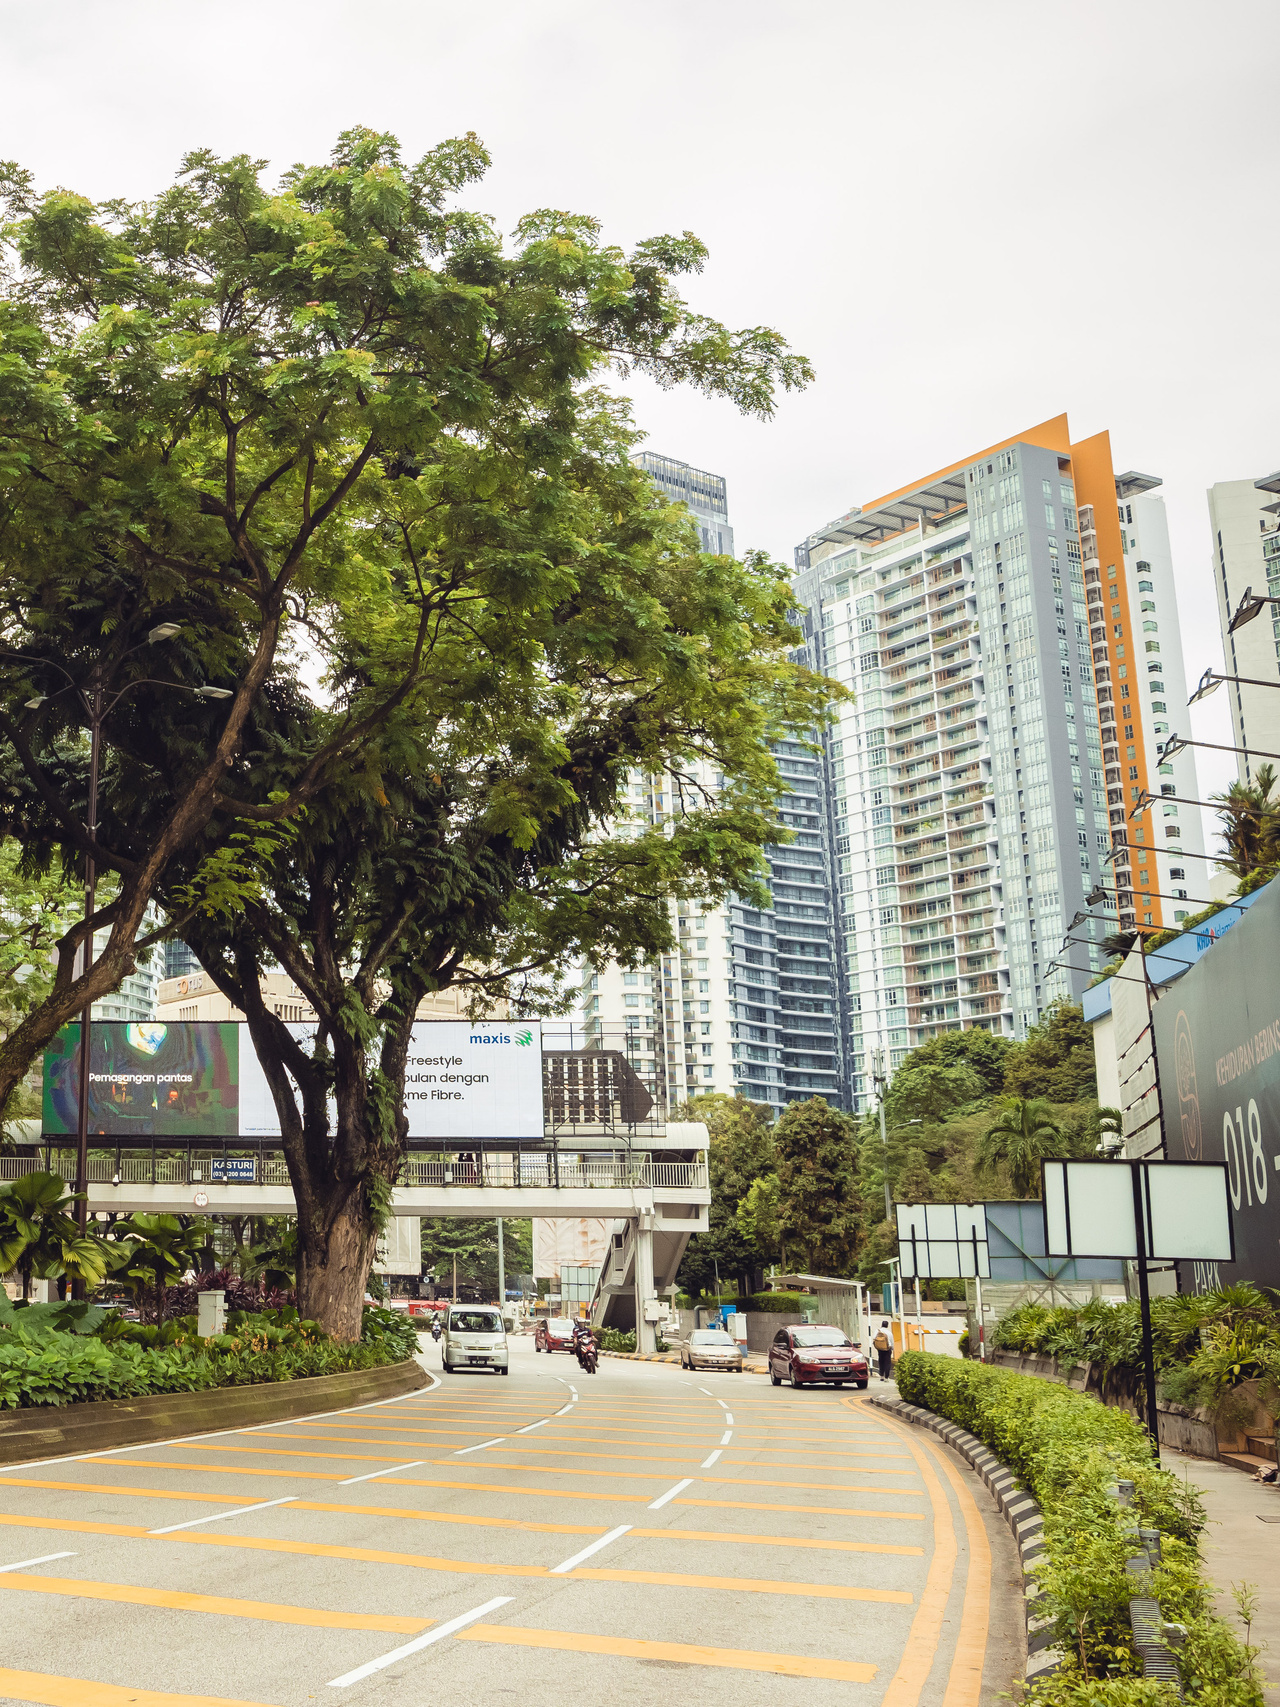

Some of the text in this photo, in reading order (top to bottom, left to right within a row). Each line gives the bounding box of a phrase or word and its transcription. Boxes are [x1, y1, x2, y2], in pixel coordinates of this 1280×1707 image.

[469, 1032, 511, 1044] maxis
[406, 1055, 463, 1068] Freestyle
[1216, 1038, 1255, 1087] KEHIDUPAN
[88, 1073, 193, 1085] Pemasangan pantas
[439, 1073, 489, 1086] dengan
[431, 1089, 465, 1100] Fibre.
[1223, 1098, 1267, 1211] 018
[1193, 1262, 1224, 1298] PARK
